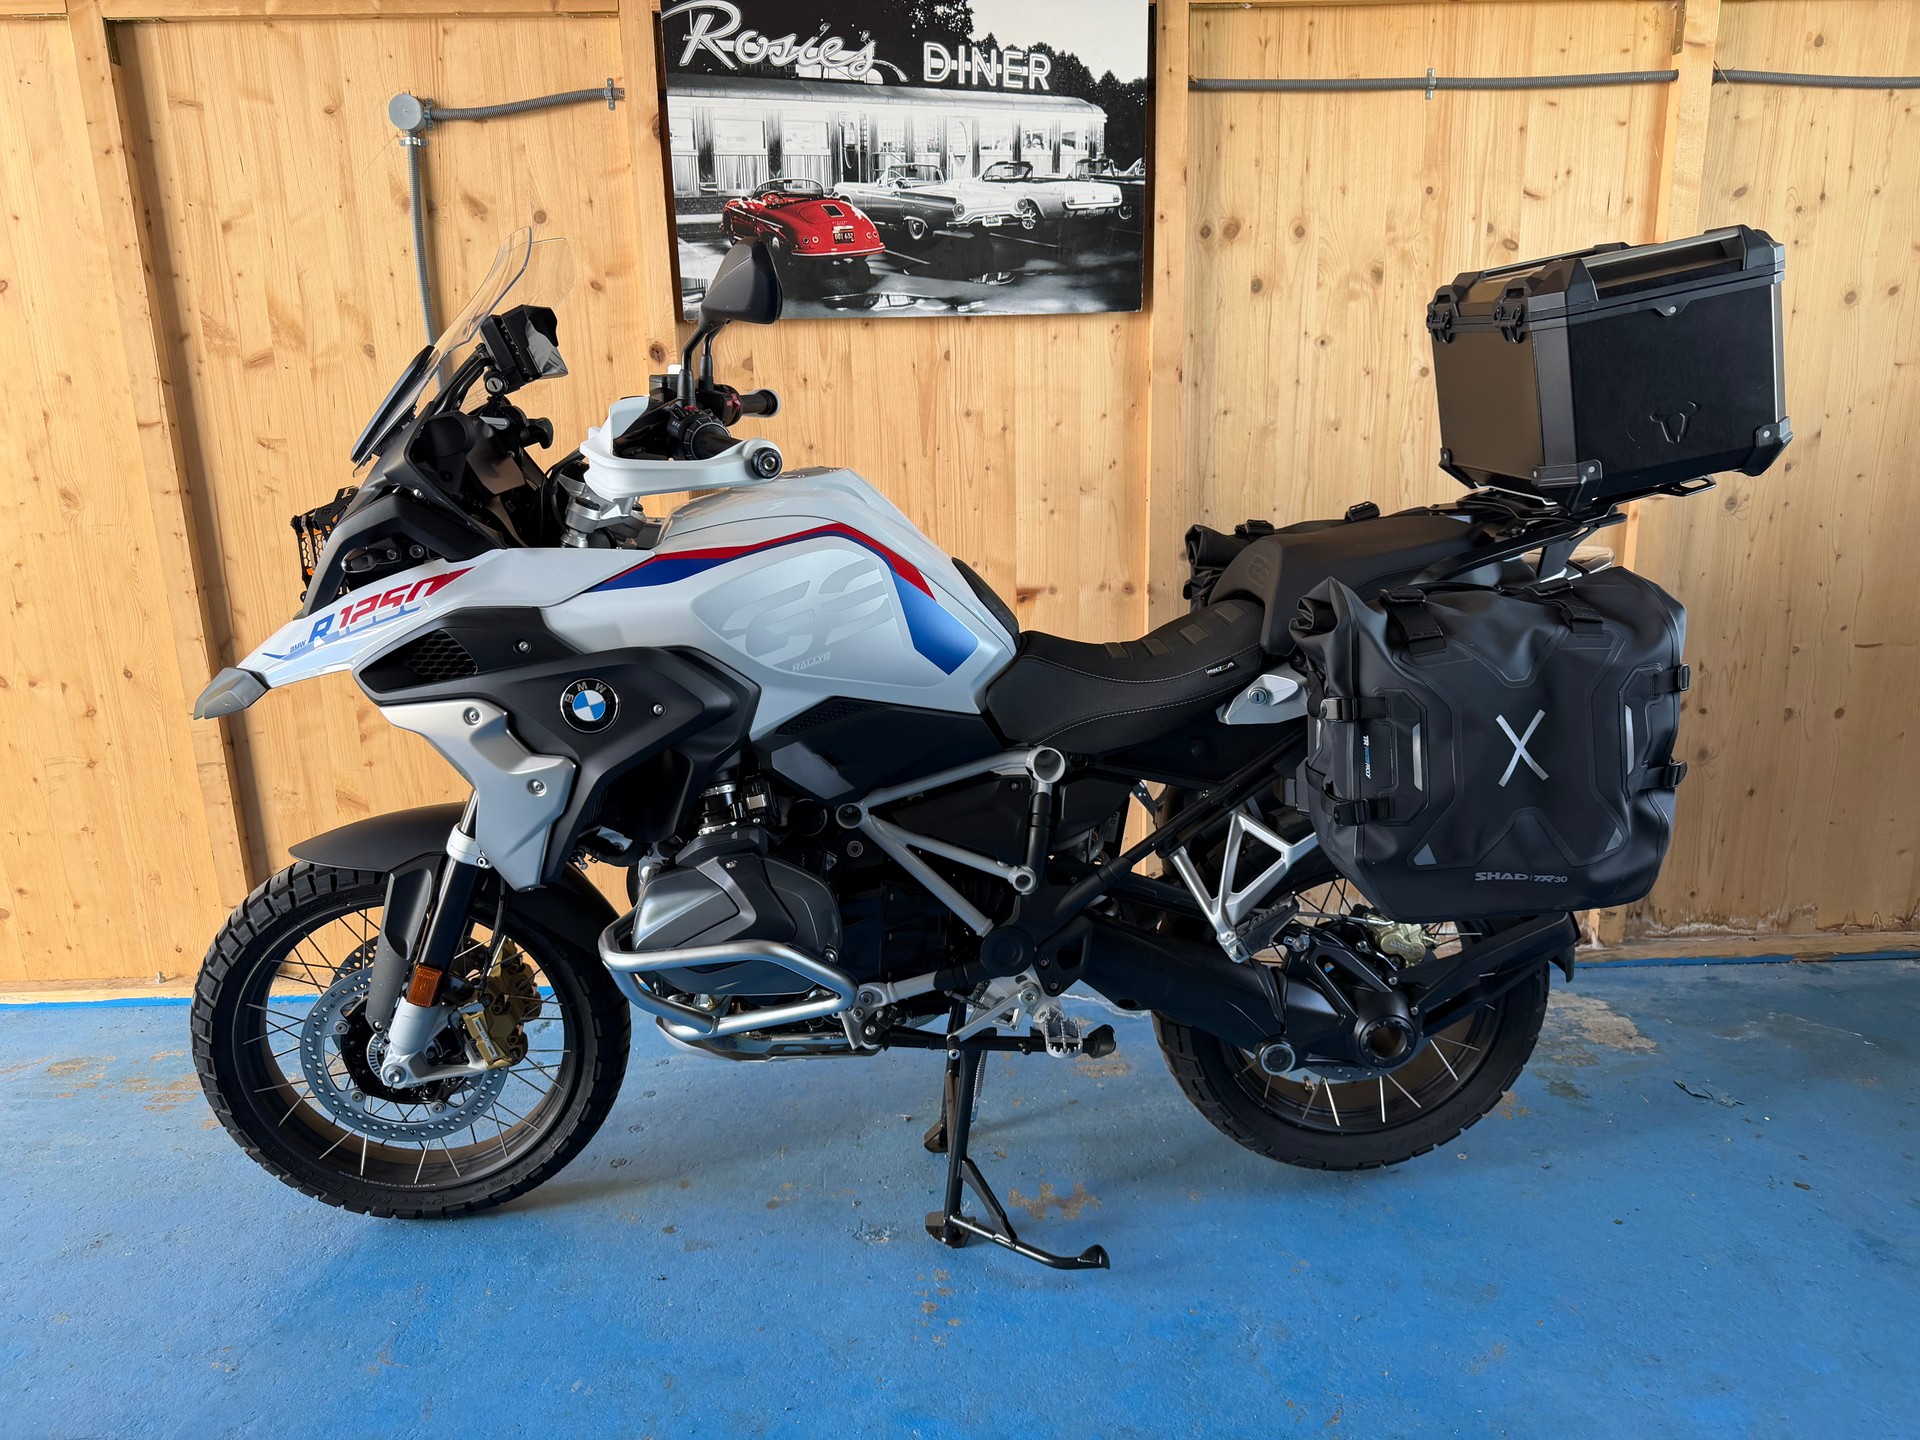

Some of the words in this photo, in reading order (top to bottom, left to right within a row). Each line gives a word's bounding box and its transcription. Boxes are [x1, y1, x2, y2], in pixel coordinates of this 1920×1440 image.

[662, 0, 908, 82] Rosie's
[923, 42, 1051, 90] DINER
[290, 639, 307, 653] BMW
[308, 613, 335, 644] R
[792, 651, 831, 672] RALLYE
[564, 681, 607, 704] BMW
[1475, 872, 1529, 881] SHAD
